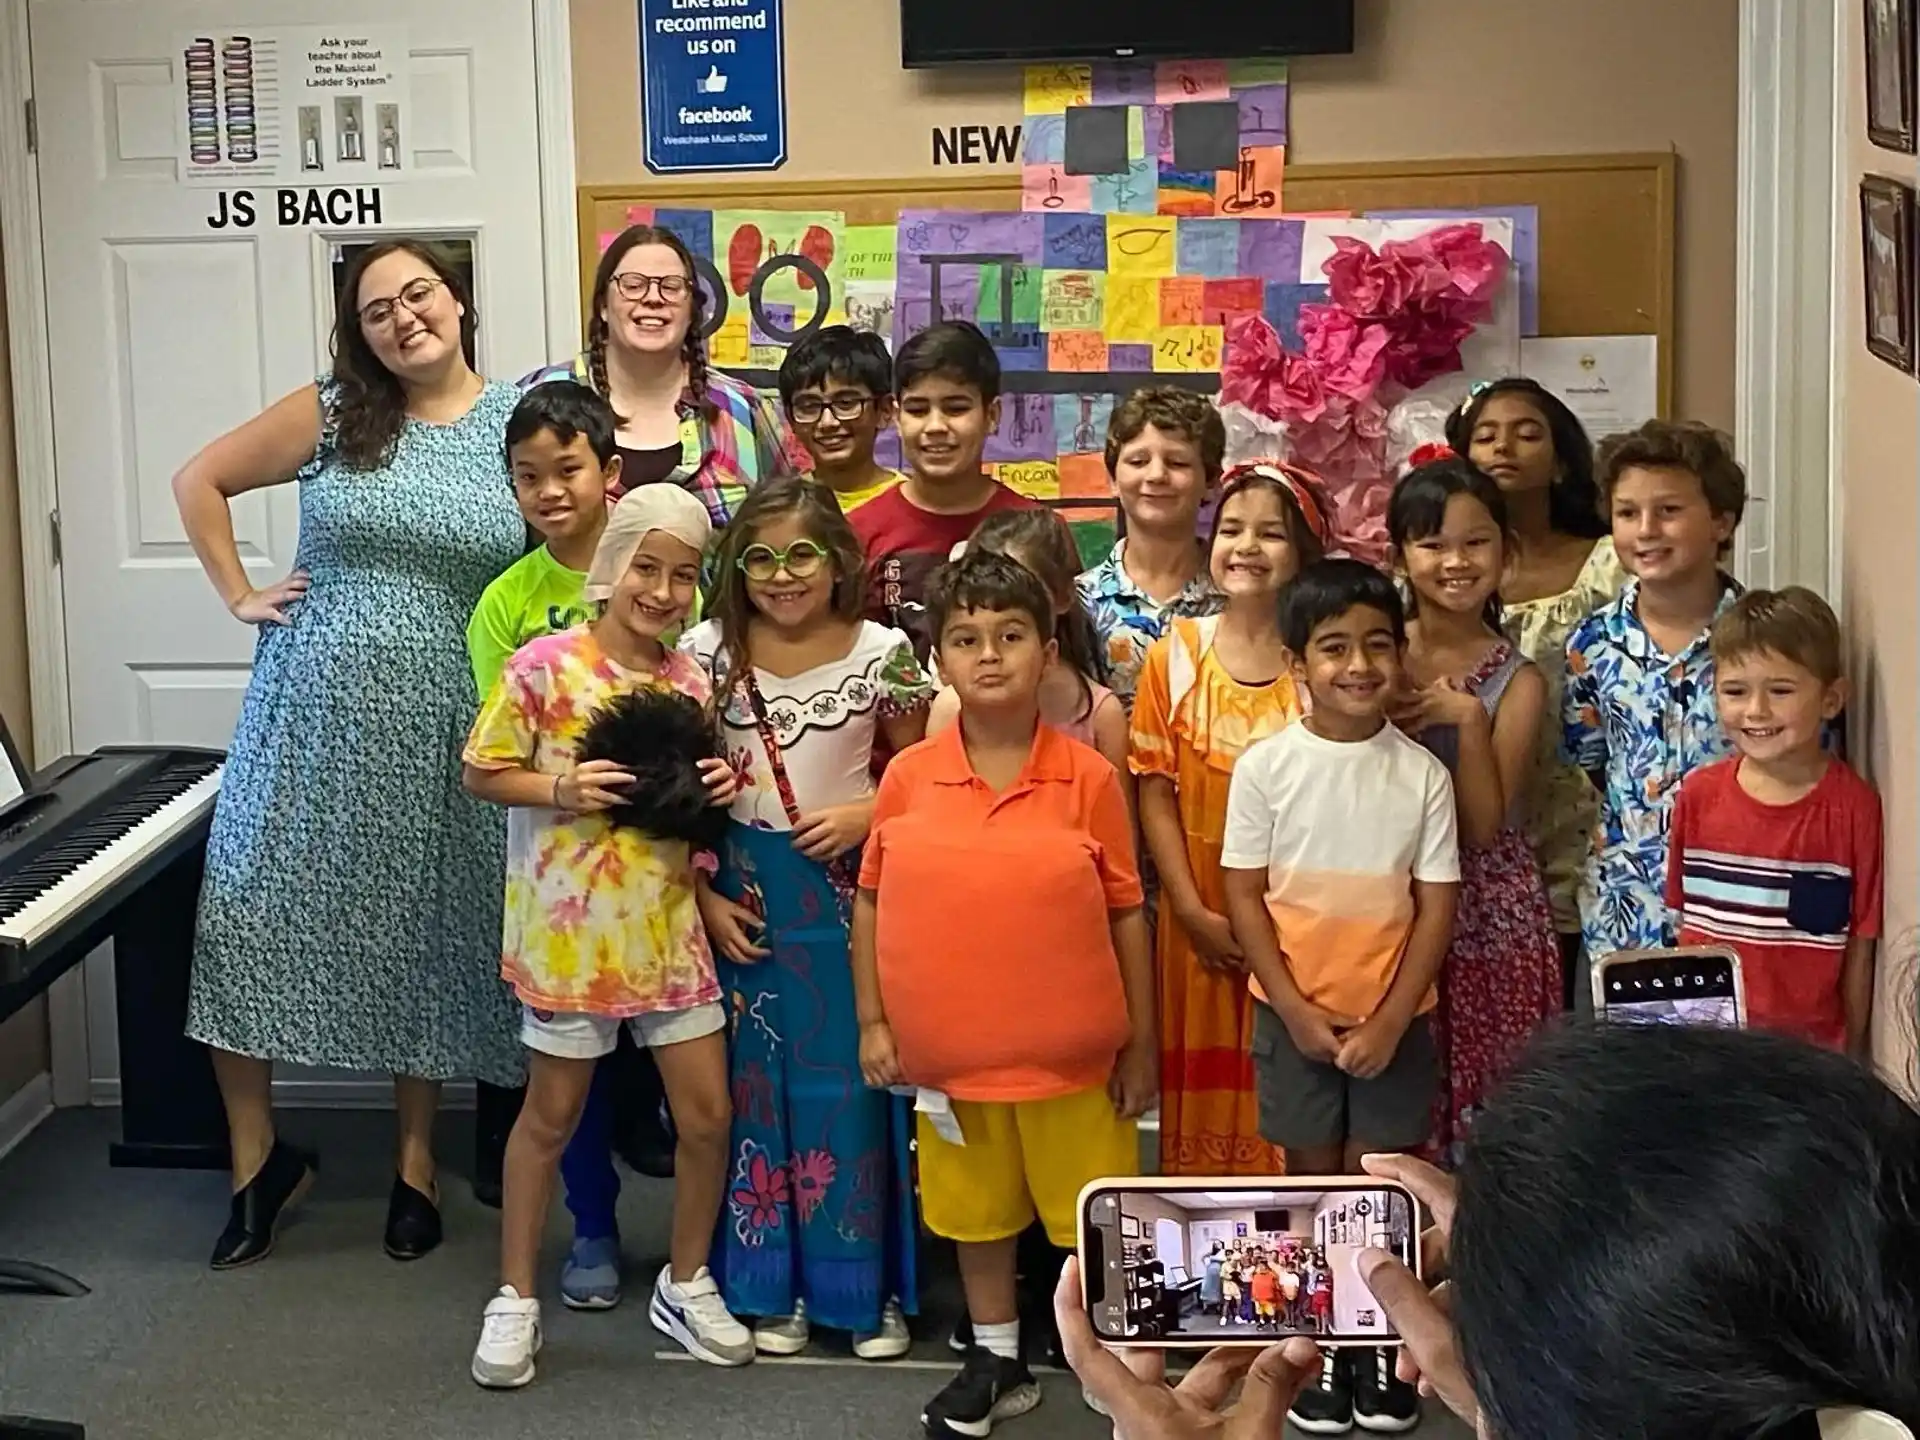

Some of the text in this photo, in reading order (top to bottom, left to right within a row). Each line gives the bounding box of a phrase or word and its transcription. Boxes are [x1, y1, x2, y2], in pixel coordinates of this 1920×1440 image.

[655, 10, 766, 33] recommend
[320, 38, 369, 49] Ask your
[686, 39, 736, 55] us on
[308, 50, 382, 61] teacher about
[315, 63, 376, 74] the Musical
[306, 78, 343, 87] Ladder
[678, 105, 753, 125] facebook
[738, 132, 768, 143] School
[932, 125, 1022, 165] NEW
[207, 188, 382, 229] JS BACH
